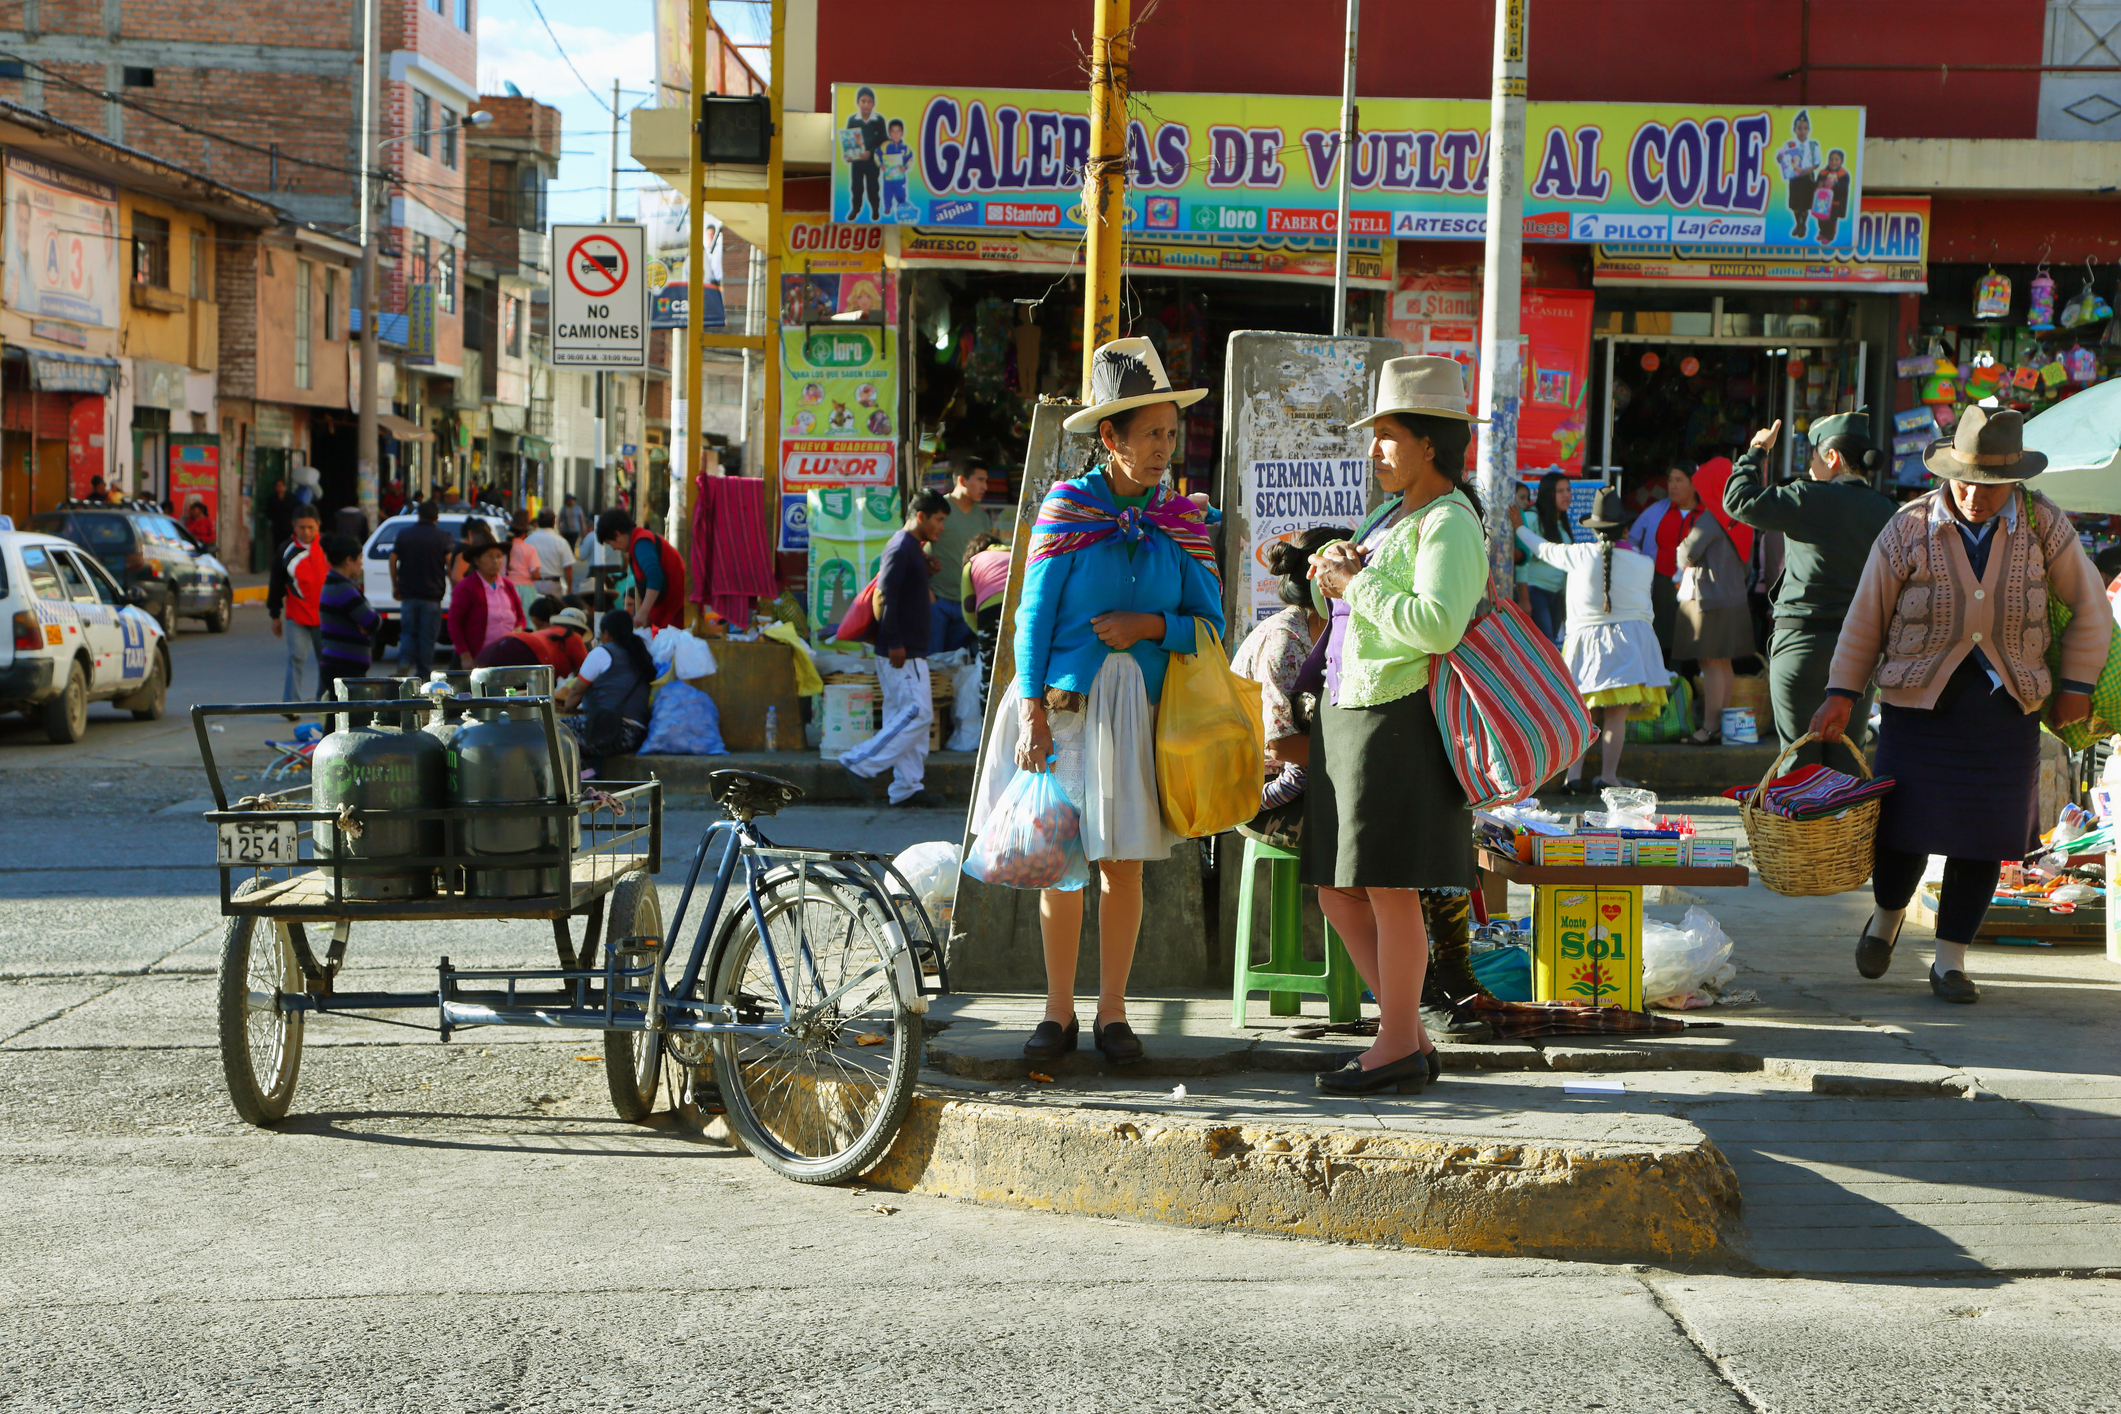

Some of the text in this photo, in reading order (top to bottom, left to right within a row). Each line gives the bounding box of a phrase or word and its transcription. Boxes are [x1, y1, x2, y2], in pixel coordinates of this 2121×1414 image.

[922, 97, 1188, 193] GALERAS
[1208, 127, 1281, 186] DE
[1534, 129, 1607, 199] AL
[1631, 115, 1768, 212] COLE
[935, 201, 975, 222] alpha
[1005, 205, 1057, 223] Stanford
[1218, 206, 1257, 229] loro
[1270, 211, 1319, 230] FABER
[789, 223, 883, 252] College
[1604, 224, 1667, 239] PILOT
[1677, 218, 1763, 239] Layconsa
[909, 238, 977, 252] ARTESCO
[981, 251, 1020, 260] VIKINGO
[1164, 252, 1218, 267] alpha
[1355, 259, 1381, 276] loro
[1711, 265, 1765, 276] VINIFAN
[1899, 266, 1921, 280] loro
[587, 304, 609, 319] NO
[558, 323, 639, 339] CAMIONES
[566, 353, 584, 361] 06:00
[833, 336, 863, 361] loro
[811, 370, 824, 378] LOS
[825, 370, 839, 379] QUE
[841, 370, 863, 378] SABEN
[865, 370, 888, 378] ELEGIR
[793, 441, 888, 452] NUEVO CUADERNO
[797, 457, 878, 475] LUXOR
[1254, 460, 1364, 489] TERMINA TU
[1255, 490, 1364, 518] SECUNDARIA
[125, 647, 144, 668] TAXI
[223, 836, 280, 860] 1254
[1560, 915, 1587, 929] Monte
[1560, 931, 1626, 960] Sol
